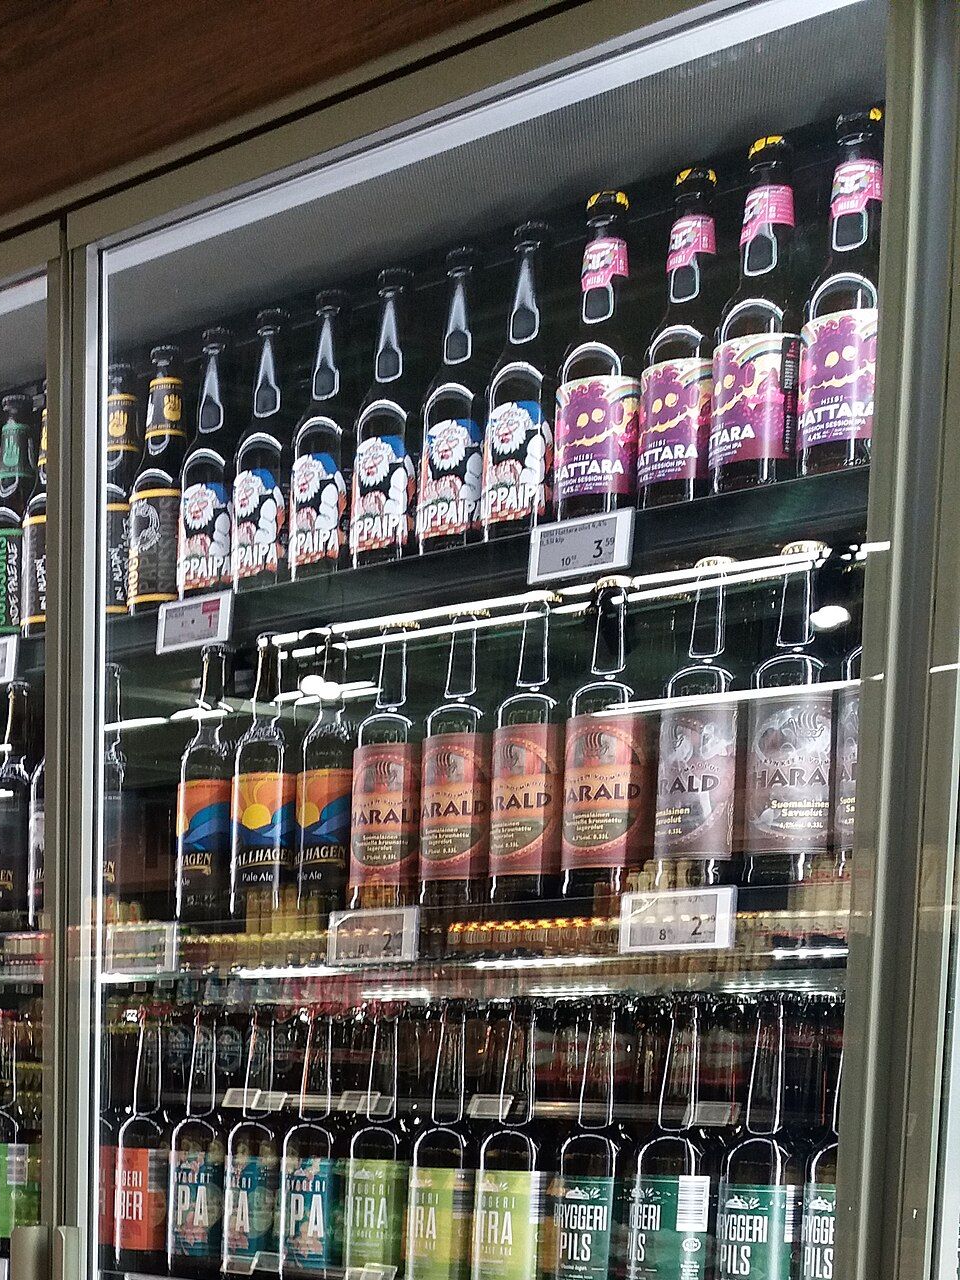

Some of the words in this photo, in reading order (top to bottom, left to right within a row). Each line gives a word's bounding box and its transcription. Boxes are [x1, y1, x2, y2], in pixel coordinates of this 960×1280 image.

[797, 400, 875, 431] HATTARA
[708, 421, 756, 453] TTARA
[554, 458, 624, 484] HATTARA
[234, 541, 277, 570] PAIPA
[592, 540, 603, 559] 3
[565, 782, 641, 804] ARALD
[242, 871, 258, 883] Pale
[259, 871, 274, 882] Ale
[691, 916, 703, 936] 2
[559, 1232, 592, 1263] PILS
[719, 1244, 752, 1276] PILS
